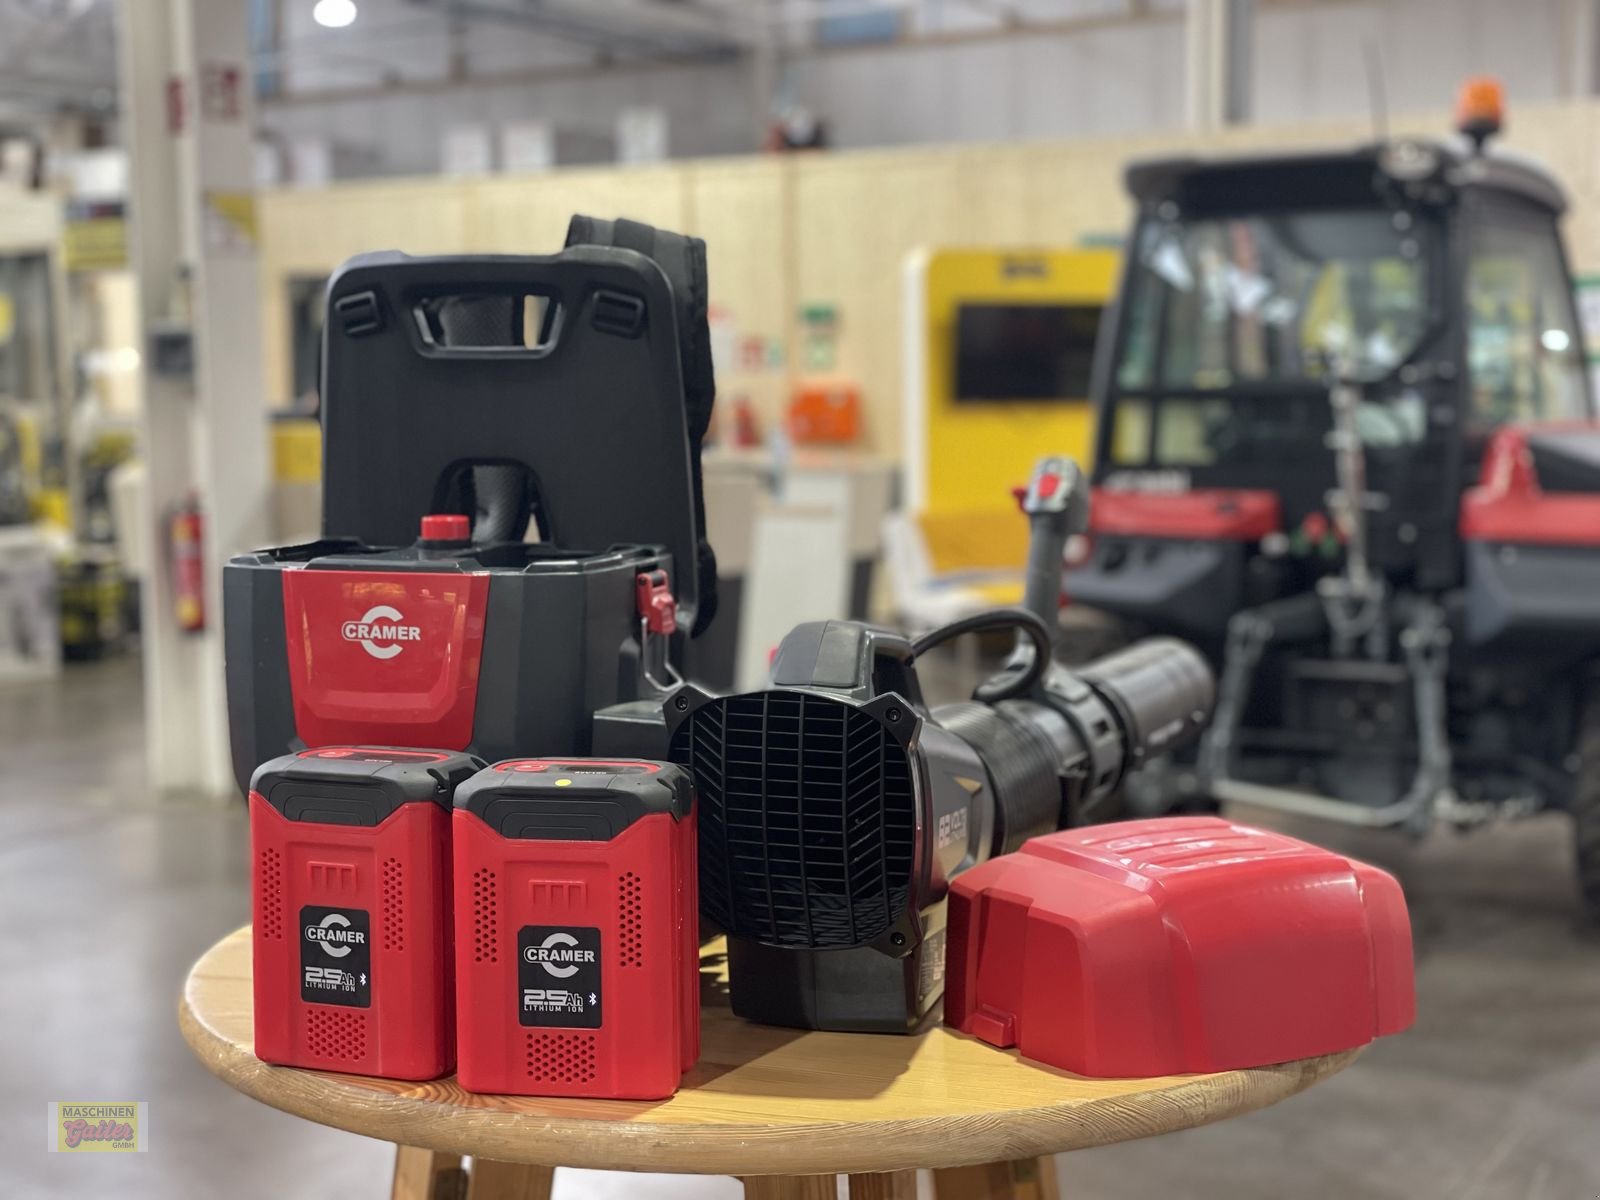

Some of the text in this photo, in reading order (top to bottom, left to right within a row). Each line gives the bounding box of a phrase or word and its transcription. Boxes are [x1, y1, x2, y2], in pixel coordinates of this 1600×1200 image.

[344, 624, 421, 641] CRAMER
[307, 927, 365, 944] CRAMER
[526, 948, 595, 963] CRAMER
[305, 981, 356, 993] LITHIUM ION
[523, 988, 584, 1007] 2.5Ah
[523, 1004, 584, 1013] LITHIUM ION
